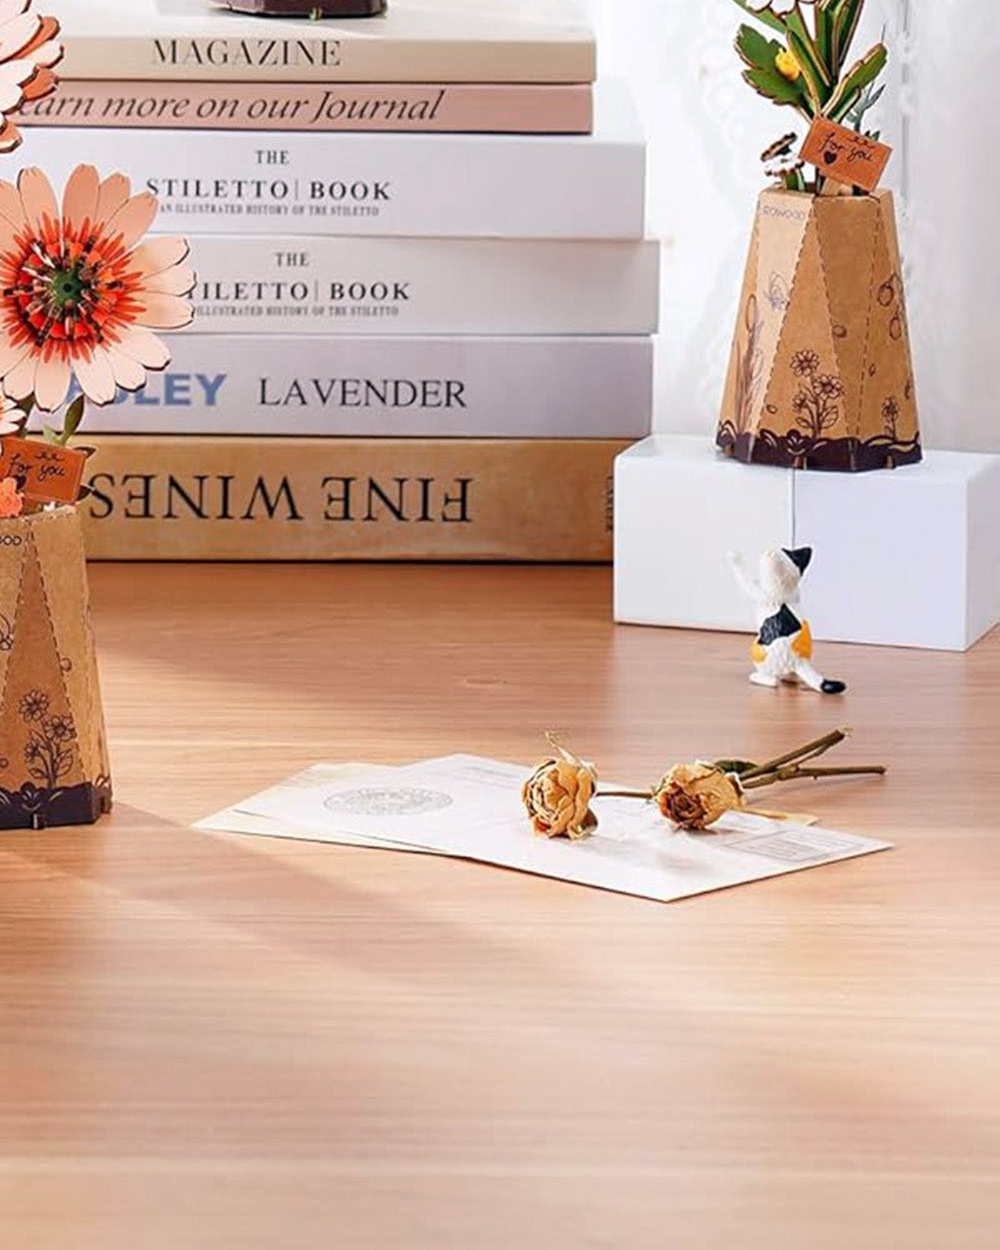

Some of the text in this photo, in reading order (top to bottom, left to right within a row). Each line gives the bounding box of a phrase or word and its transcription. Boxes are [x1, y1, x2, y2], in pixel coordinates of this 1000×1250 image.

[151, 38, 341, 66] MAGAZINE
[101, 97, 191, 119] more
[197, 98, 240, 118] on
[246, 98, 309, 120] our
[310, 89, 446, 124] Journal
[255, 150, 290, 165] THE
[146, 179, 391, 201] STILETTO BOOK
[275, 252, 309, 267] THE
[330, 282, 410, 301] BOOK
[259, 377, 468, 409] LAVENDER
[88, 472, 474, 524] FINE WINES
